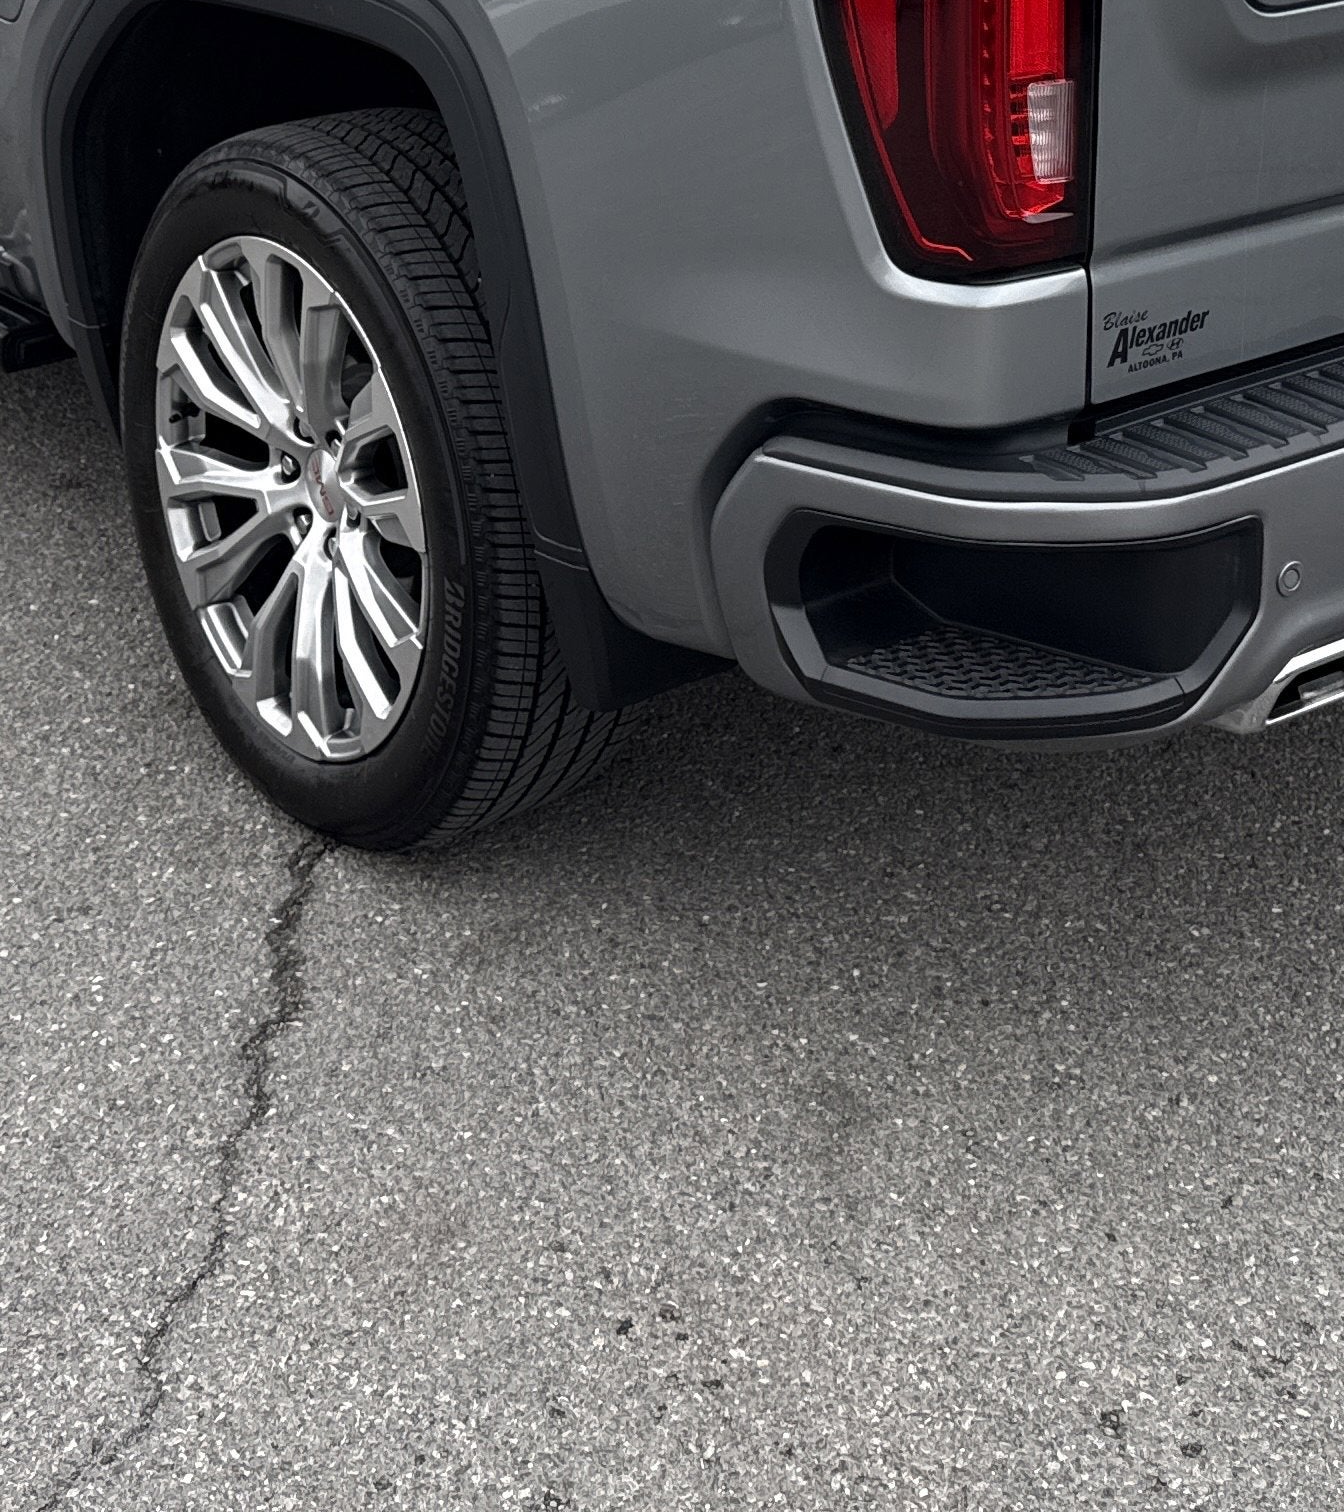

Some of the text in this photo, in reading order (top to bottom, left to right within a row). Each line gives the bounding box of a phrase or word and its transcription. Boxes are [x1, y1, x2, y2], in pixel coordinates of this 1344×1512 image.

[1103, 309, 1149, 331] Blaise
[1107, 309, 1210, 368] Alexander
[1171, 350, 1183, 363] PA
